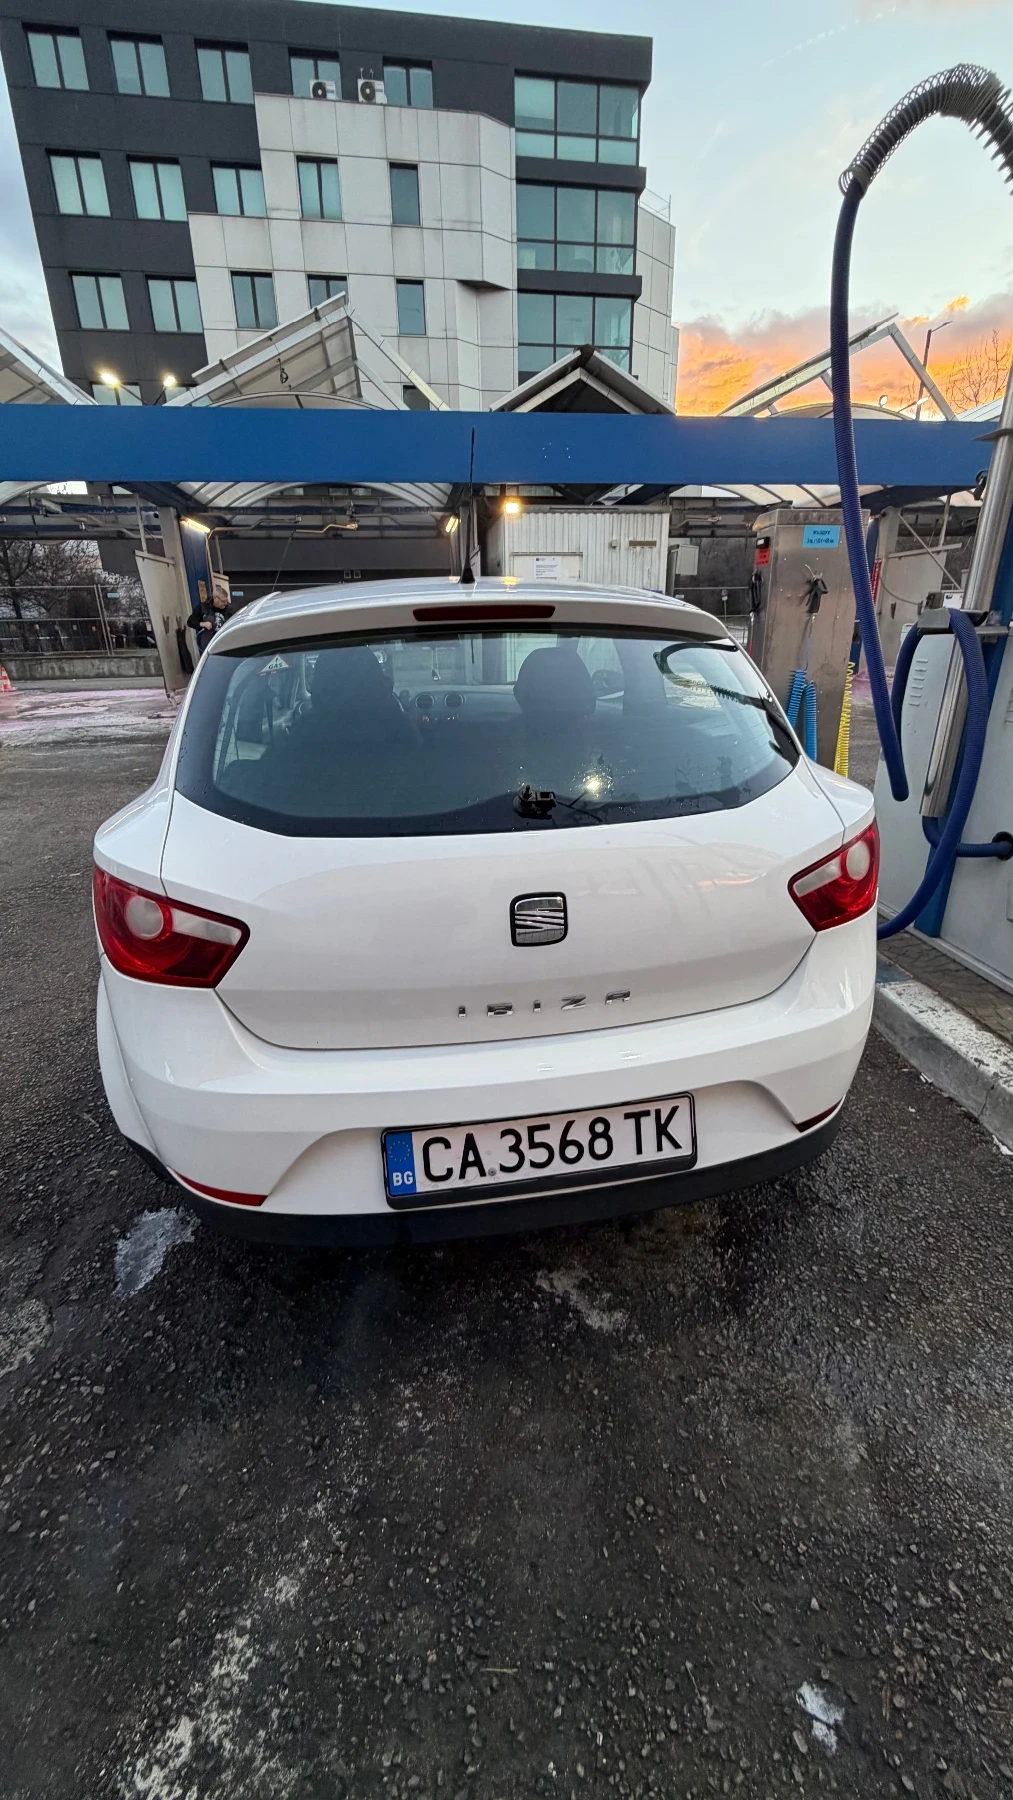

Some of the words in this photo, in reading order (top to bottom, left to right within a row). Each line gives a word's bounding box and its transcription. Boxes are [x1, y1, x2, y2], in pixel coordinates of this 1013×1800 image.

[268, 662, 283, 670] GAS
[458, 989, 631, 1018] IBIZA
[422, 1132, 487, 1182] CA
[499, 1116, 614, 1173] 3568
[623, 1105, 683, 1156] TK
[392, 1170, 414, 1187] BG
